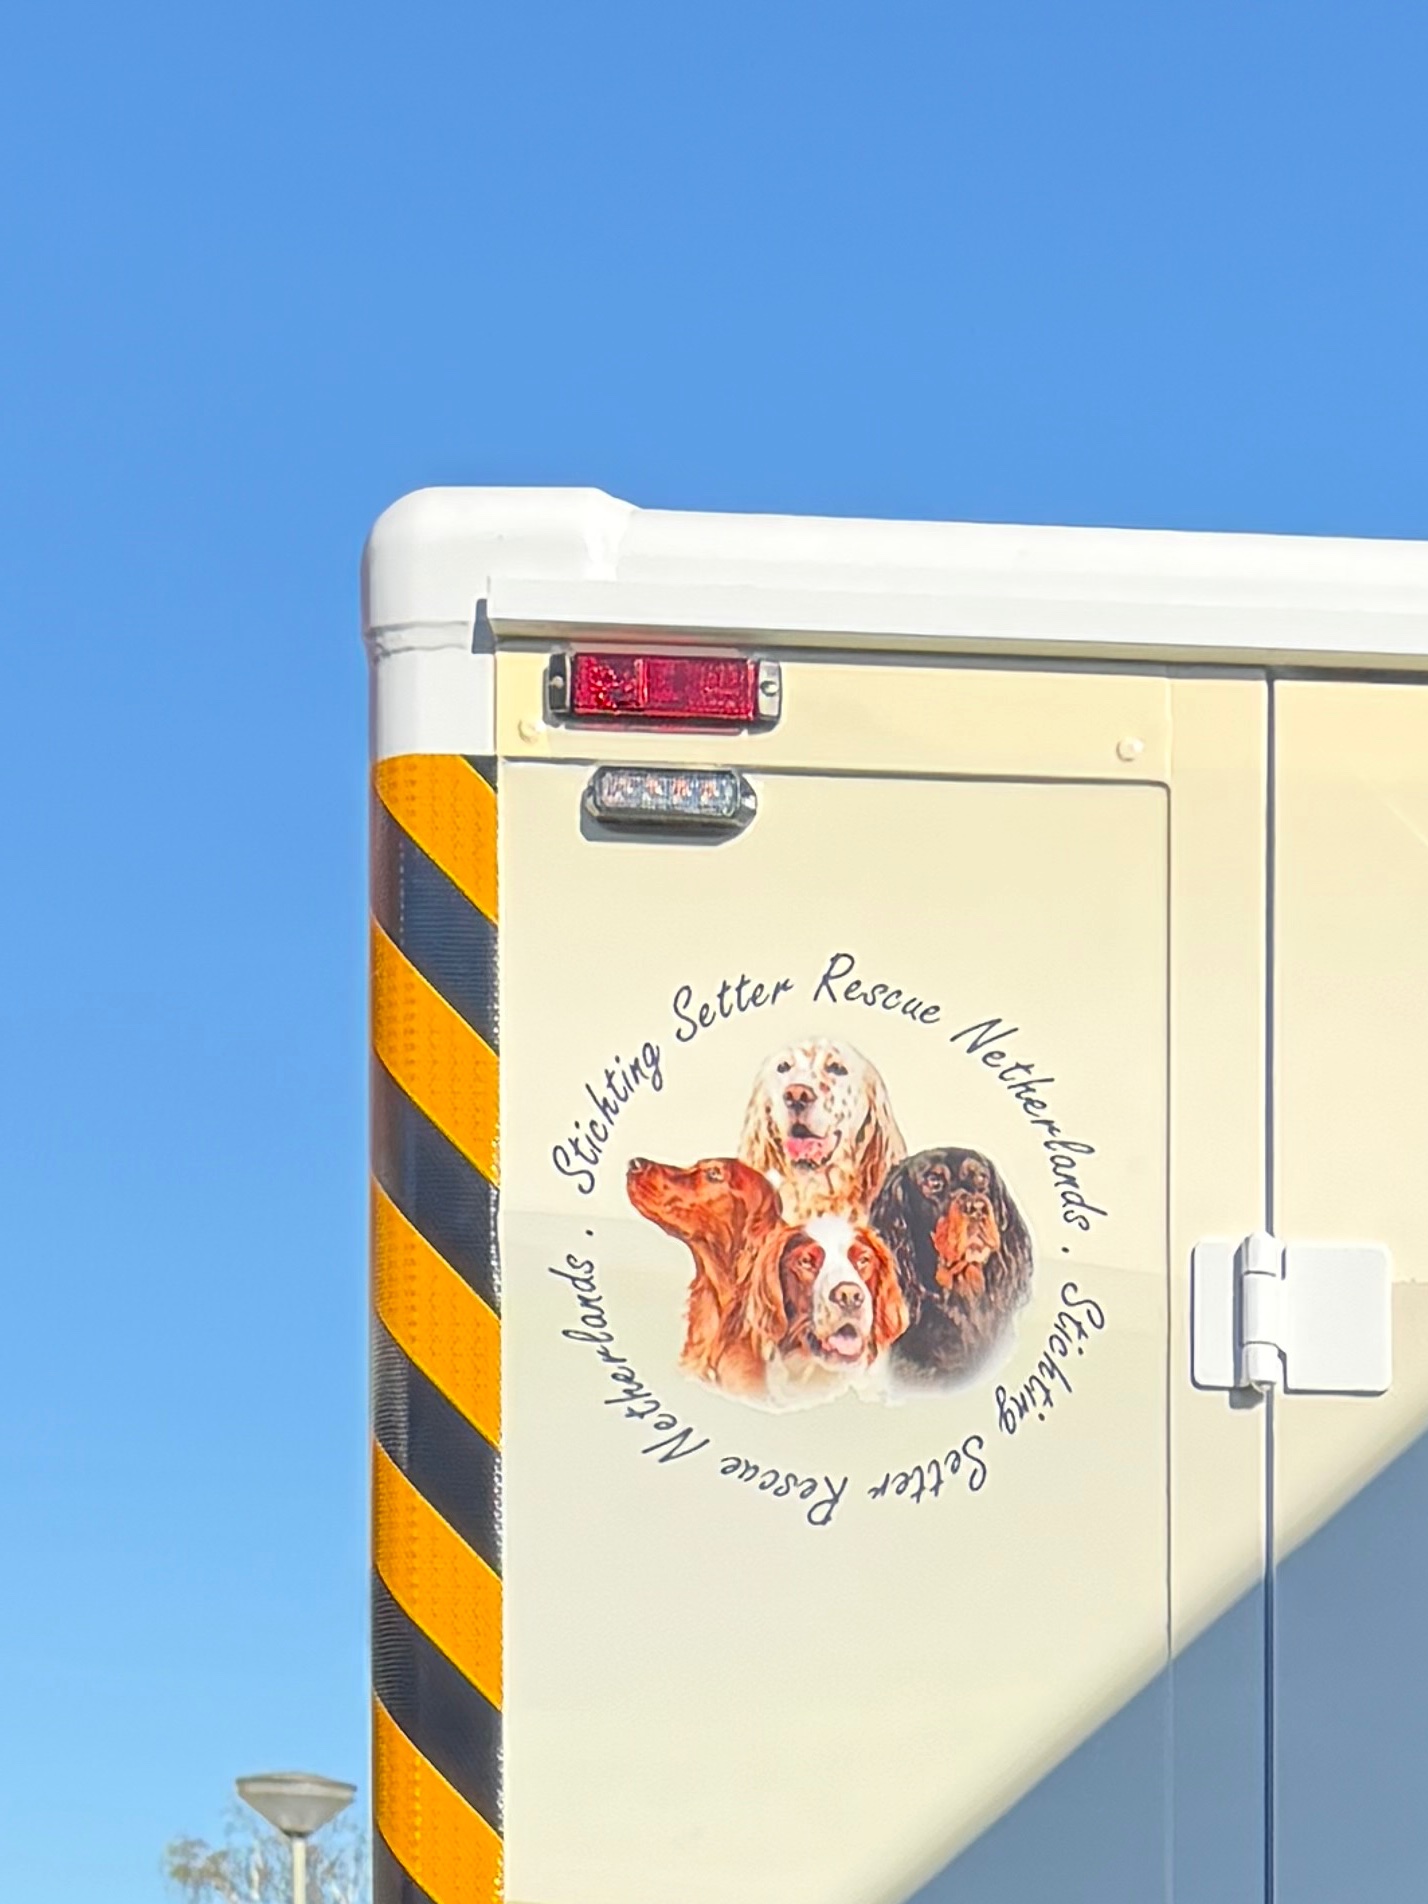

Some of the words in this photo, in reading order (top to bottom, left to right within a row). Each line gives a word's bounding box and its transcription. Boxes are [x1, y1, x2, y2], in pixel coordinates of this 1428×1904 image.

[552, 1042, 663, 1195] Stichting
[673, 973, 794, 1042] Setter
[813, 952, 940, 1024] Rescue
[950, 1018, 1108, 1231] Netherlands
[548, 1253, 710, 1463] Netherlands
[995, 1282, 1105, 1434] Stichting
[720, 1456, 848, 1525] Rescue
[868, 1435, 987, 1503] Setter
